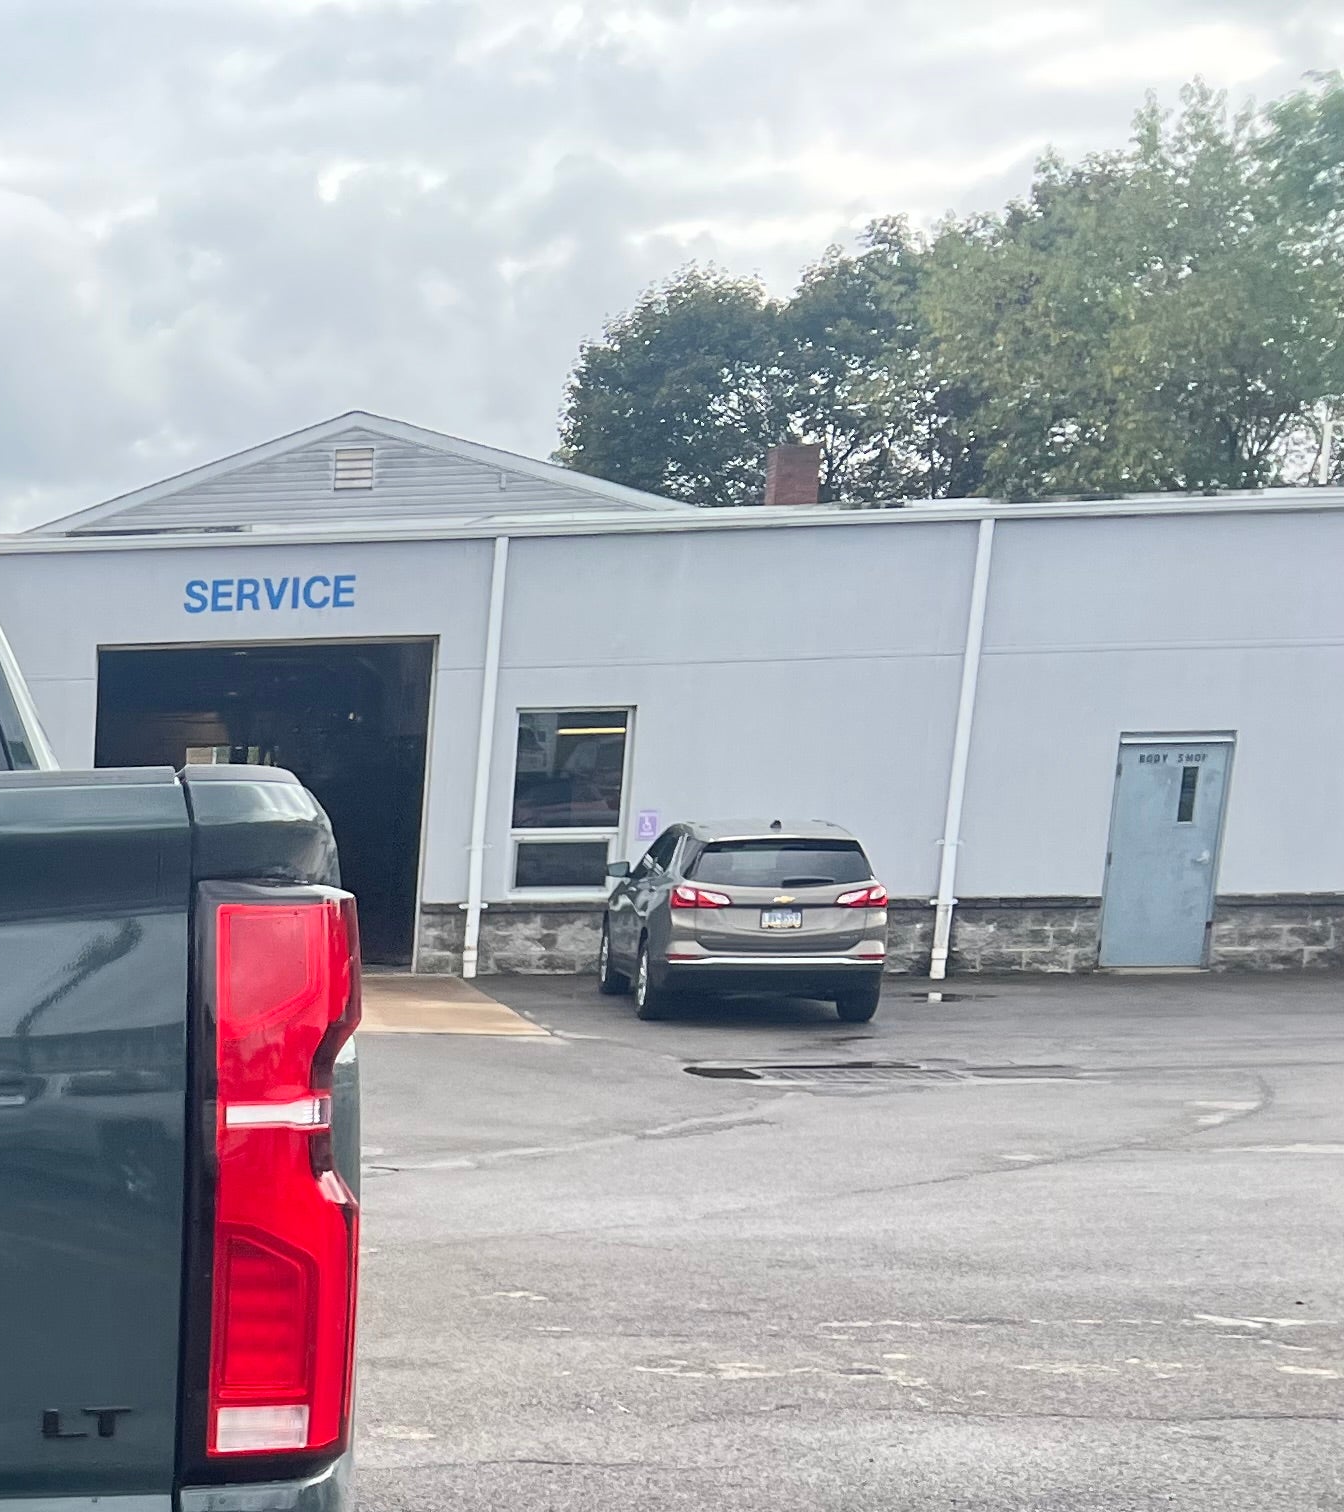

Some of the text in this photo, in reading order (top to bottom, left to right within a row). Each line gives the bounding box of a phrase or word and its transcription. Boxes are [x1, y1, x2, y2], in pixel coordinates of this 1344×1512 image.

[183, 575, 357, 614] SERVICE
[1139, 753, 1168, 763] BODY
[42, 1406, 132, 1438] LT
